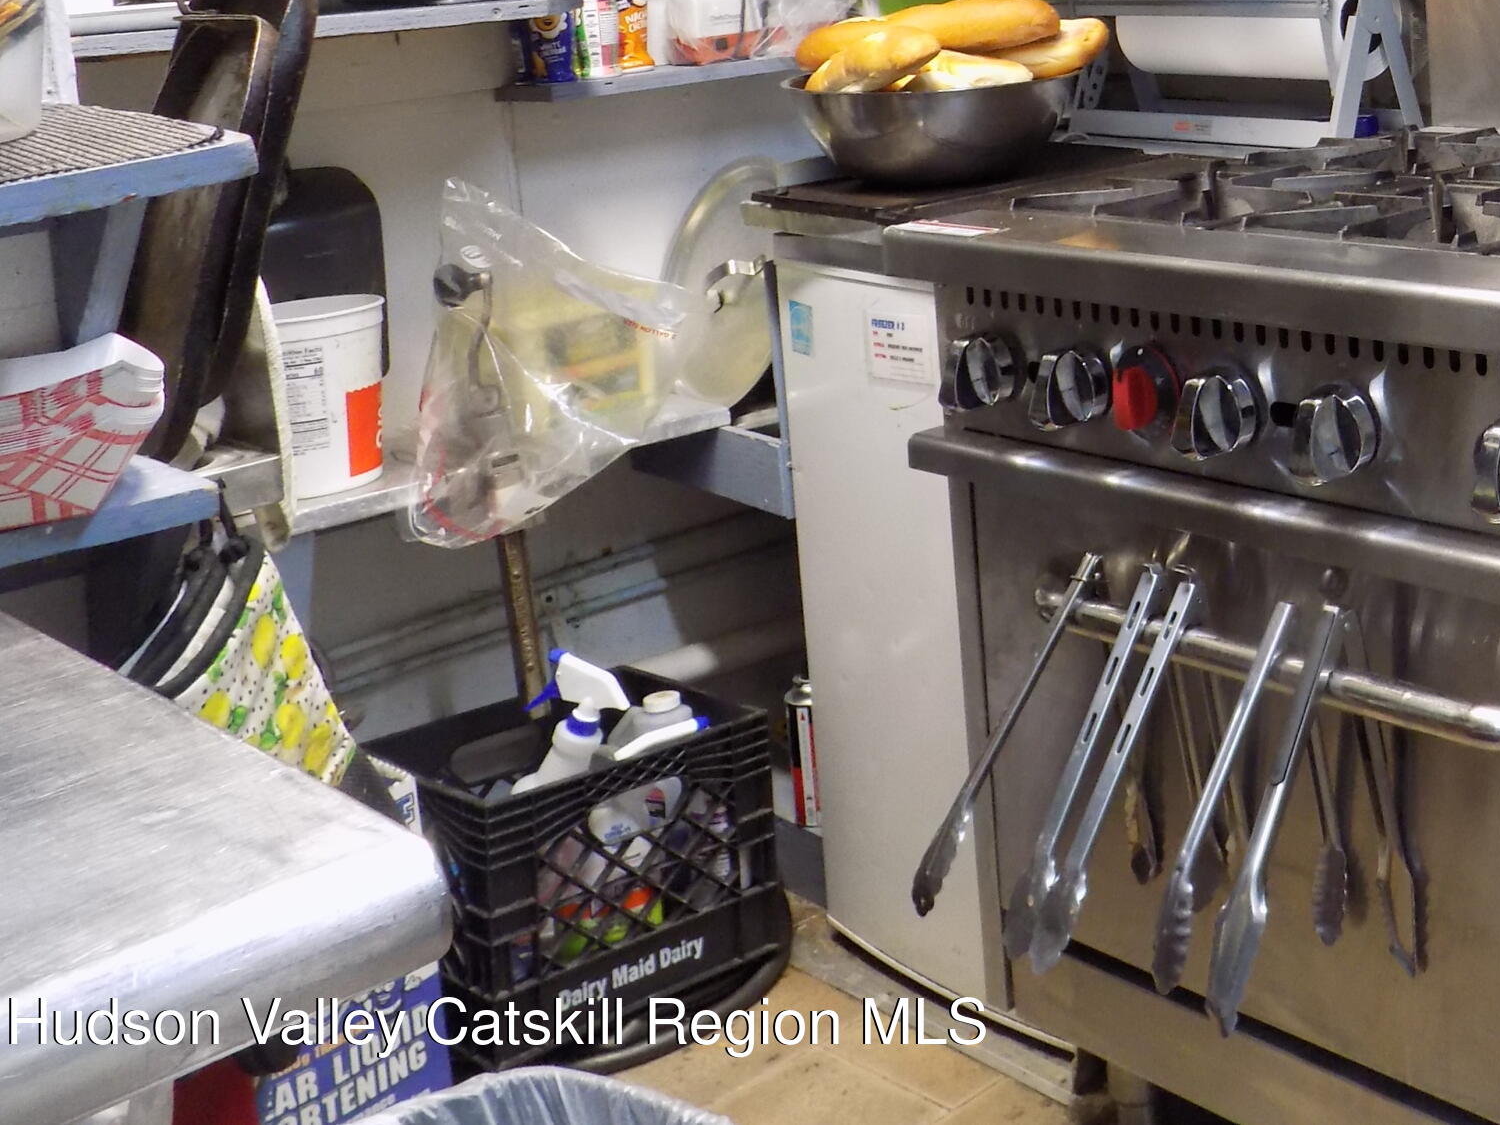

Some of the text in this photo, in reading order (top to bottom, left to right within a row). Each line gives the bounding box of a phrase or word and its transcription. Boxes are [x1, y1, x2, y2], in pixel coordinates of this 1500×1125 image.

[558, 936, 705, 1012] Dairy Maid Dairy
[278, 1040, 428, 1125] RTENING
